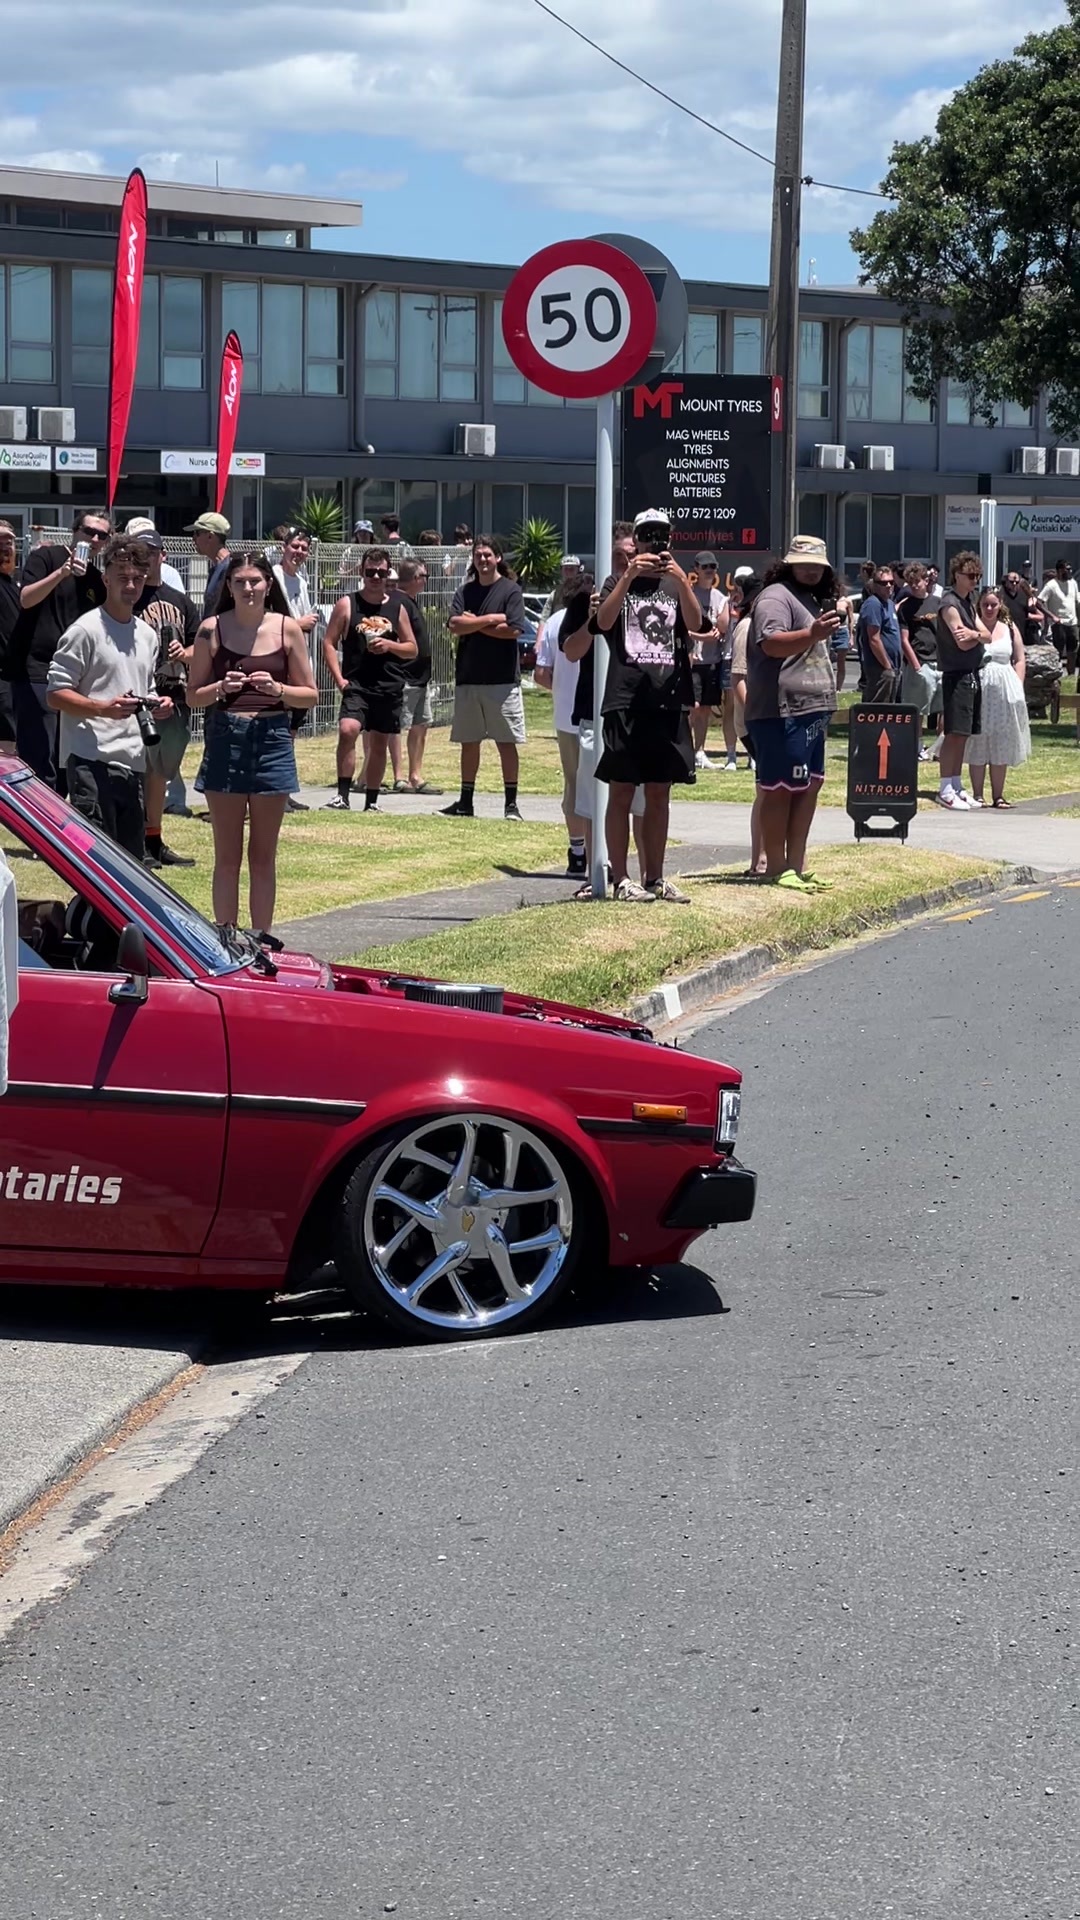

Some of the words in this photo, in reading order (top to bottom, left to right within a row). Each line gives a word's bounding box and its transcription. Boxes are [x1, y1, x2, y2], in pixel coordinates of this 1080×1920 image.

[126, 223, 138, 305] AON
[541, 287, 622, 349] 50
[224, 360, 237, 416] AON
[680, 399, 725, 412] MOUNT
[727, 400, 763, 413] TYRES
[773, 387, 781, 420] 9
[666, 430, 690, 440] MAG
[691, 430, 730, 441] WHEELS
[683, 444, 713, 455] TYRES
[189, 457, 208, 466] Nurse
[666, 458, 730, 470] ALIGNMENTS
[669, 472, 726, 483] PUNCTURES
[673, 487, 722, 498] BATTERIES
[677, 507, 690, 519] 07
[692, 508, 711, 519] 572
[713, 508, 736, 519] 1209
[1031, 514, 1080, 525] AsureQuality
[1031, 524, 1059, 532] Kaitiaki
[1060, 524, 1072, 532] Kai
[857, 713, 912, 723] COFFEE
[855, 784, 910, 794] NITROUS
[0, 1165, 122, 1204] taries
